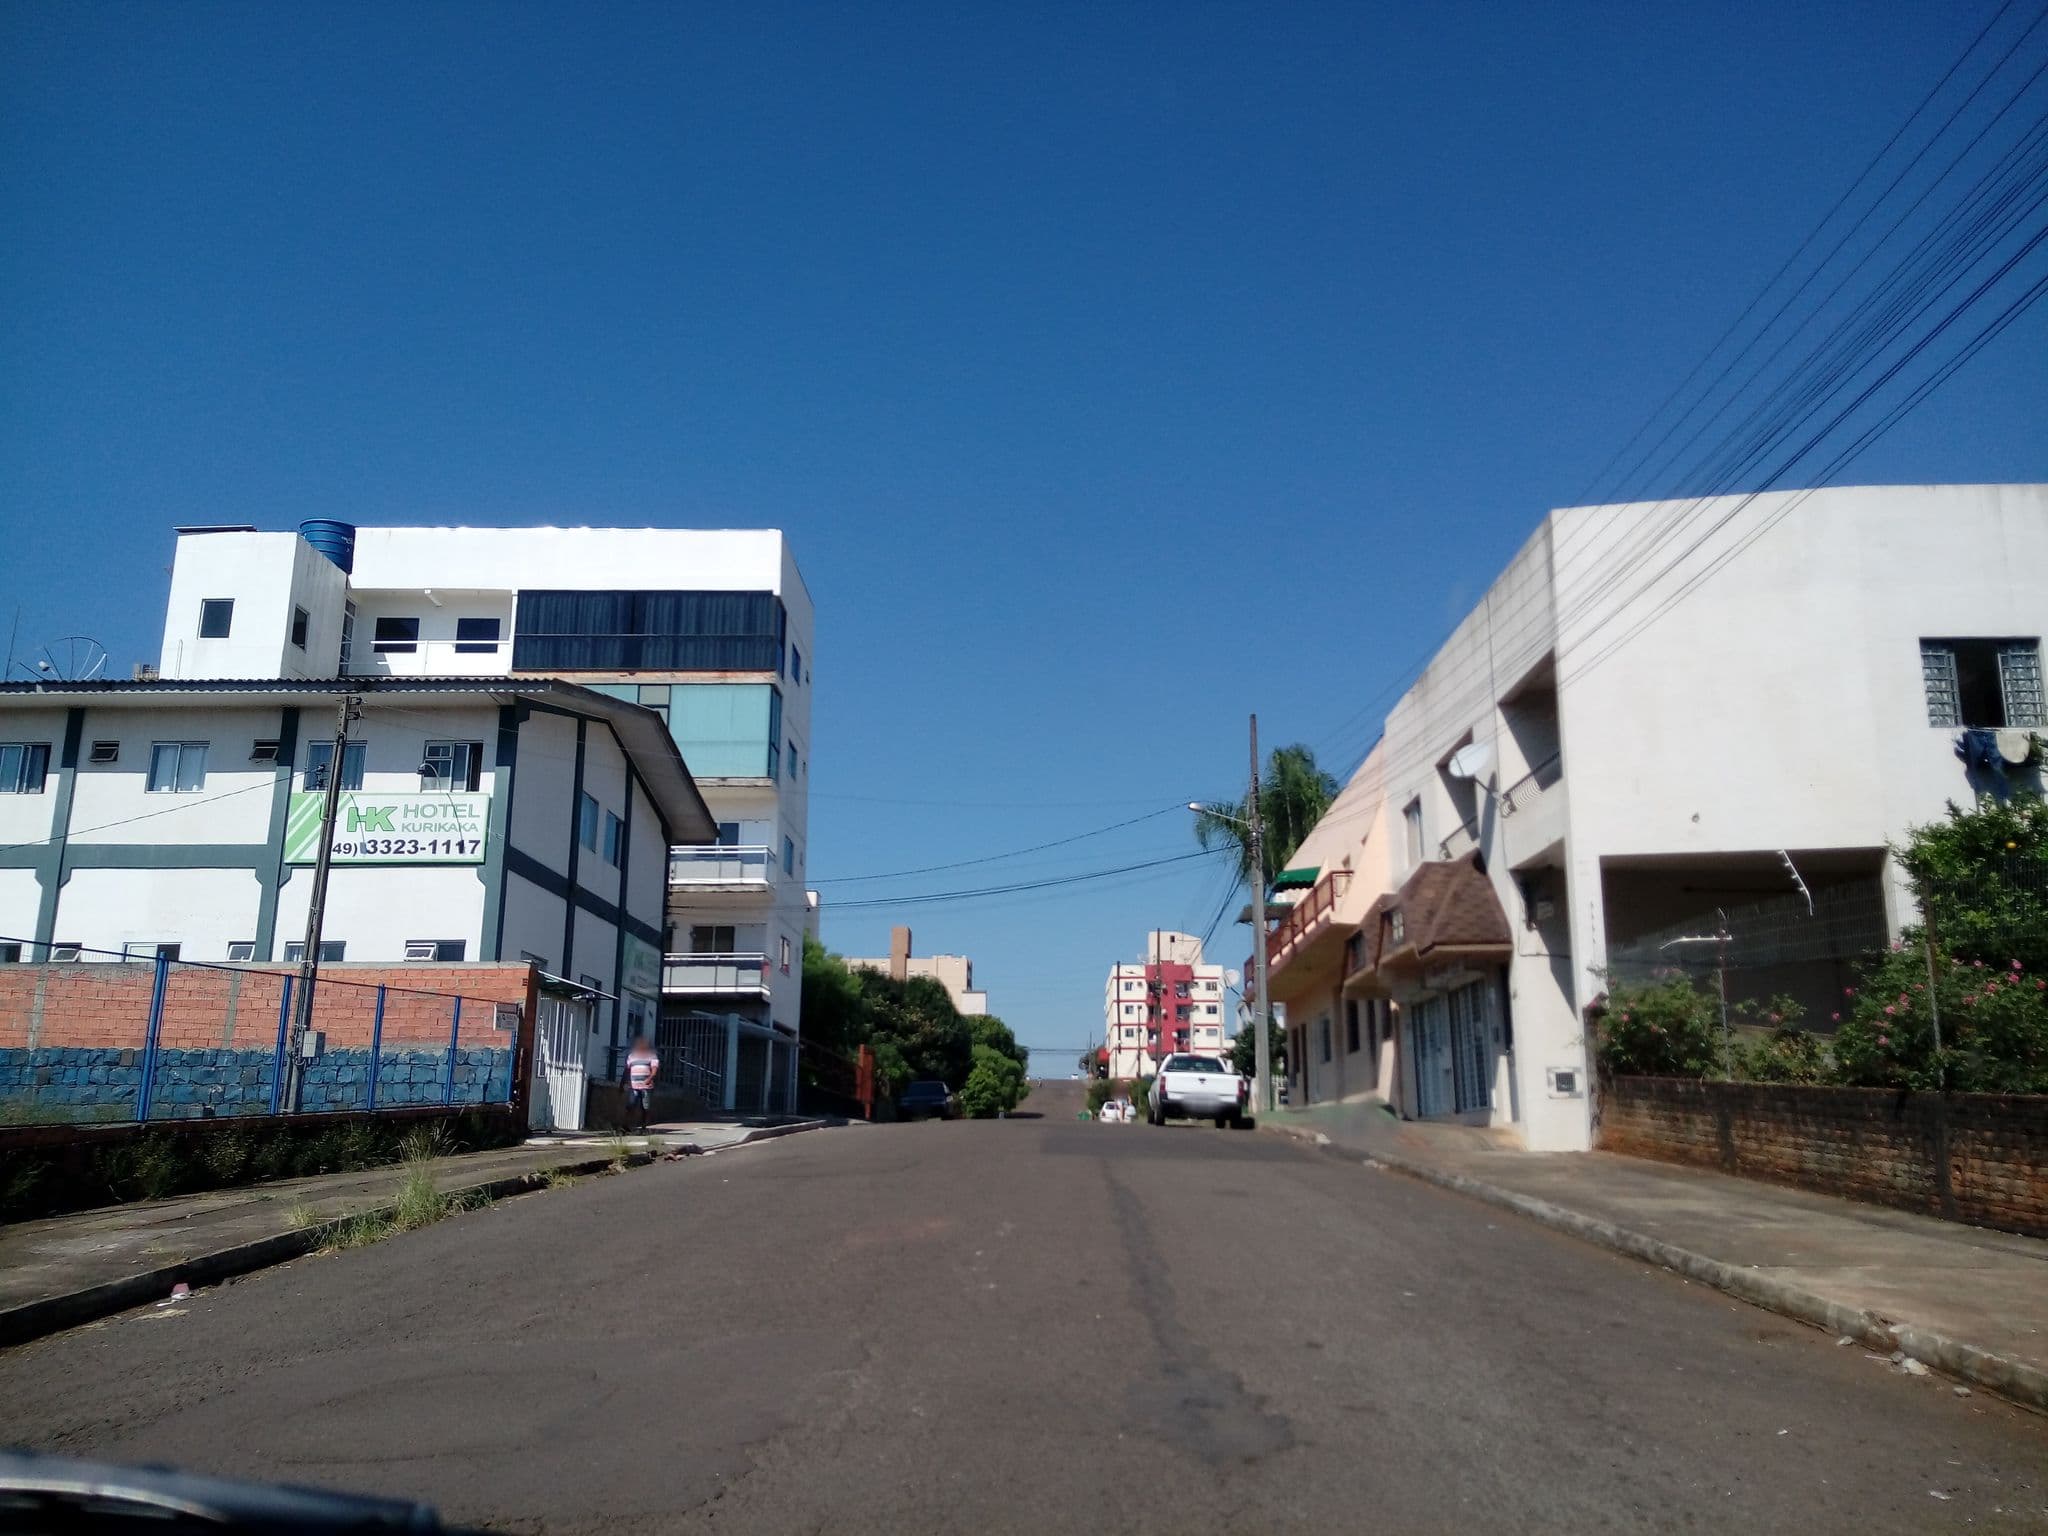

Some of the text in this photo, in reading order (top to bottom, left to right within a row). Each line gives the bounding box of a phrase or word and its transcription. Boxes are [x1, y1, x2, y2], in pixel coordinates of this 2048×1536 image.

[346, 806, 398, 833] HK
[403, 803, 481, 819] HOTEL
[401, 822, 479, 833] KURIKAKA
[331, 839, 481, 858] 49) 3323-1117
